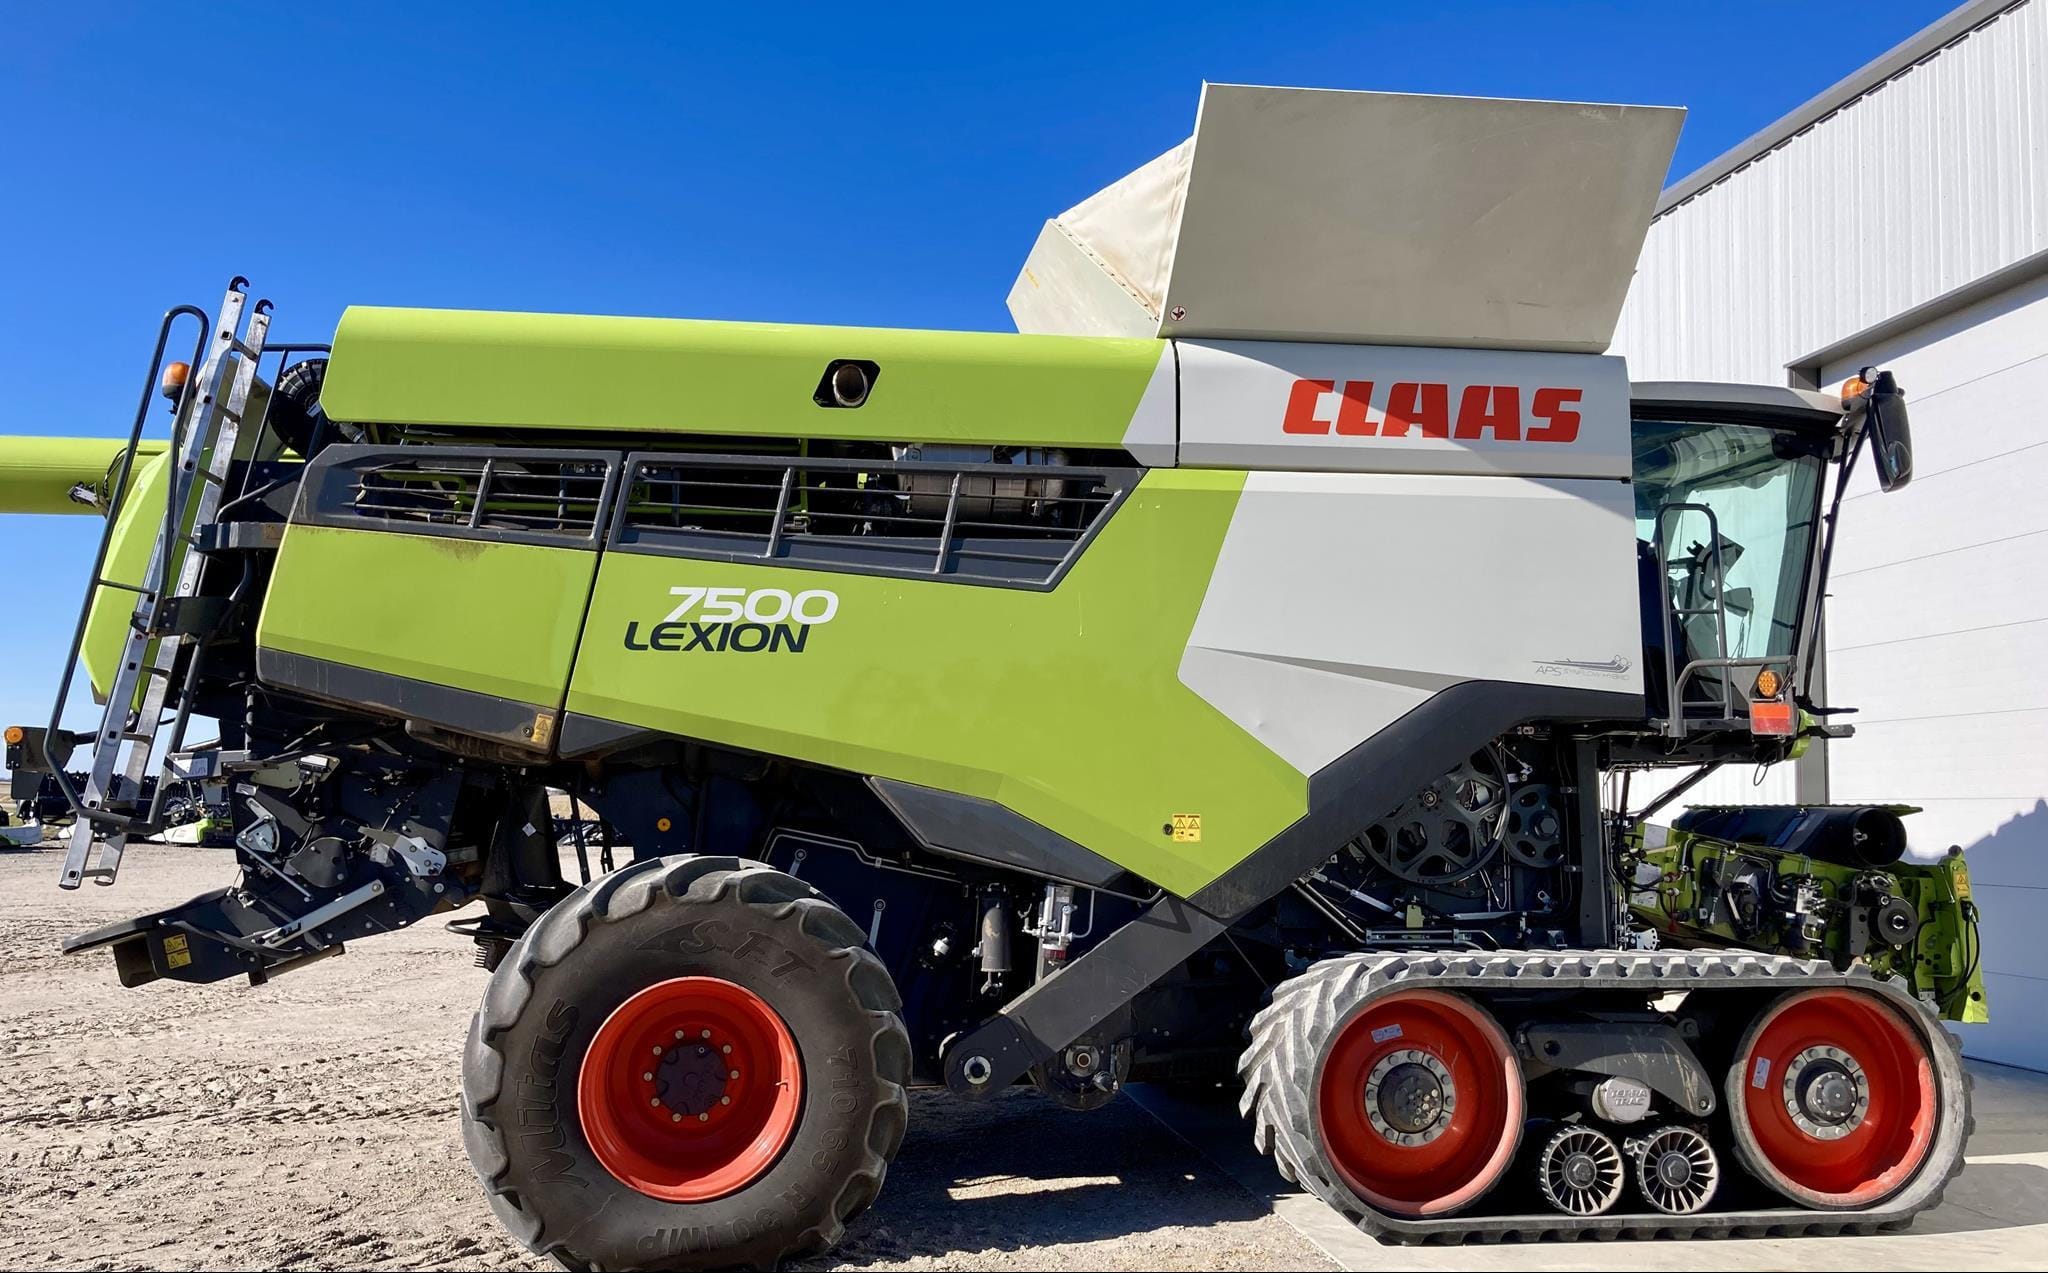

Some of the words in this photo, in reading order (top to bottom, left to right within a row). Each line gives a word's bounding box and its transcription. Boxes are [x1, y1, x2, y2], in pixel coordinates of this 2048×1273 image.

[1283, 380, 1583, 442] CLAAS
[663, 586, 839, 624] 7500
[624, 621, 810, 653] LEXION
[1535, 665, 1562, 677] APS
[829, 1047, 859, 1114] 710
[1614, 1098, 1644, 1106] TRAC
[637, 1223, 718, 1256] IMP
